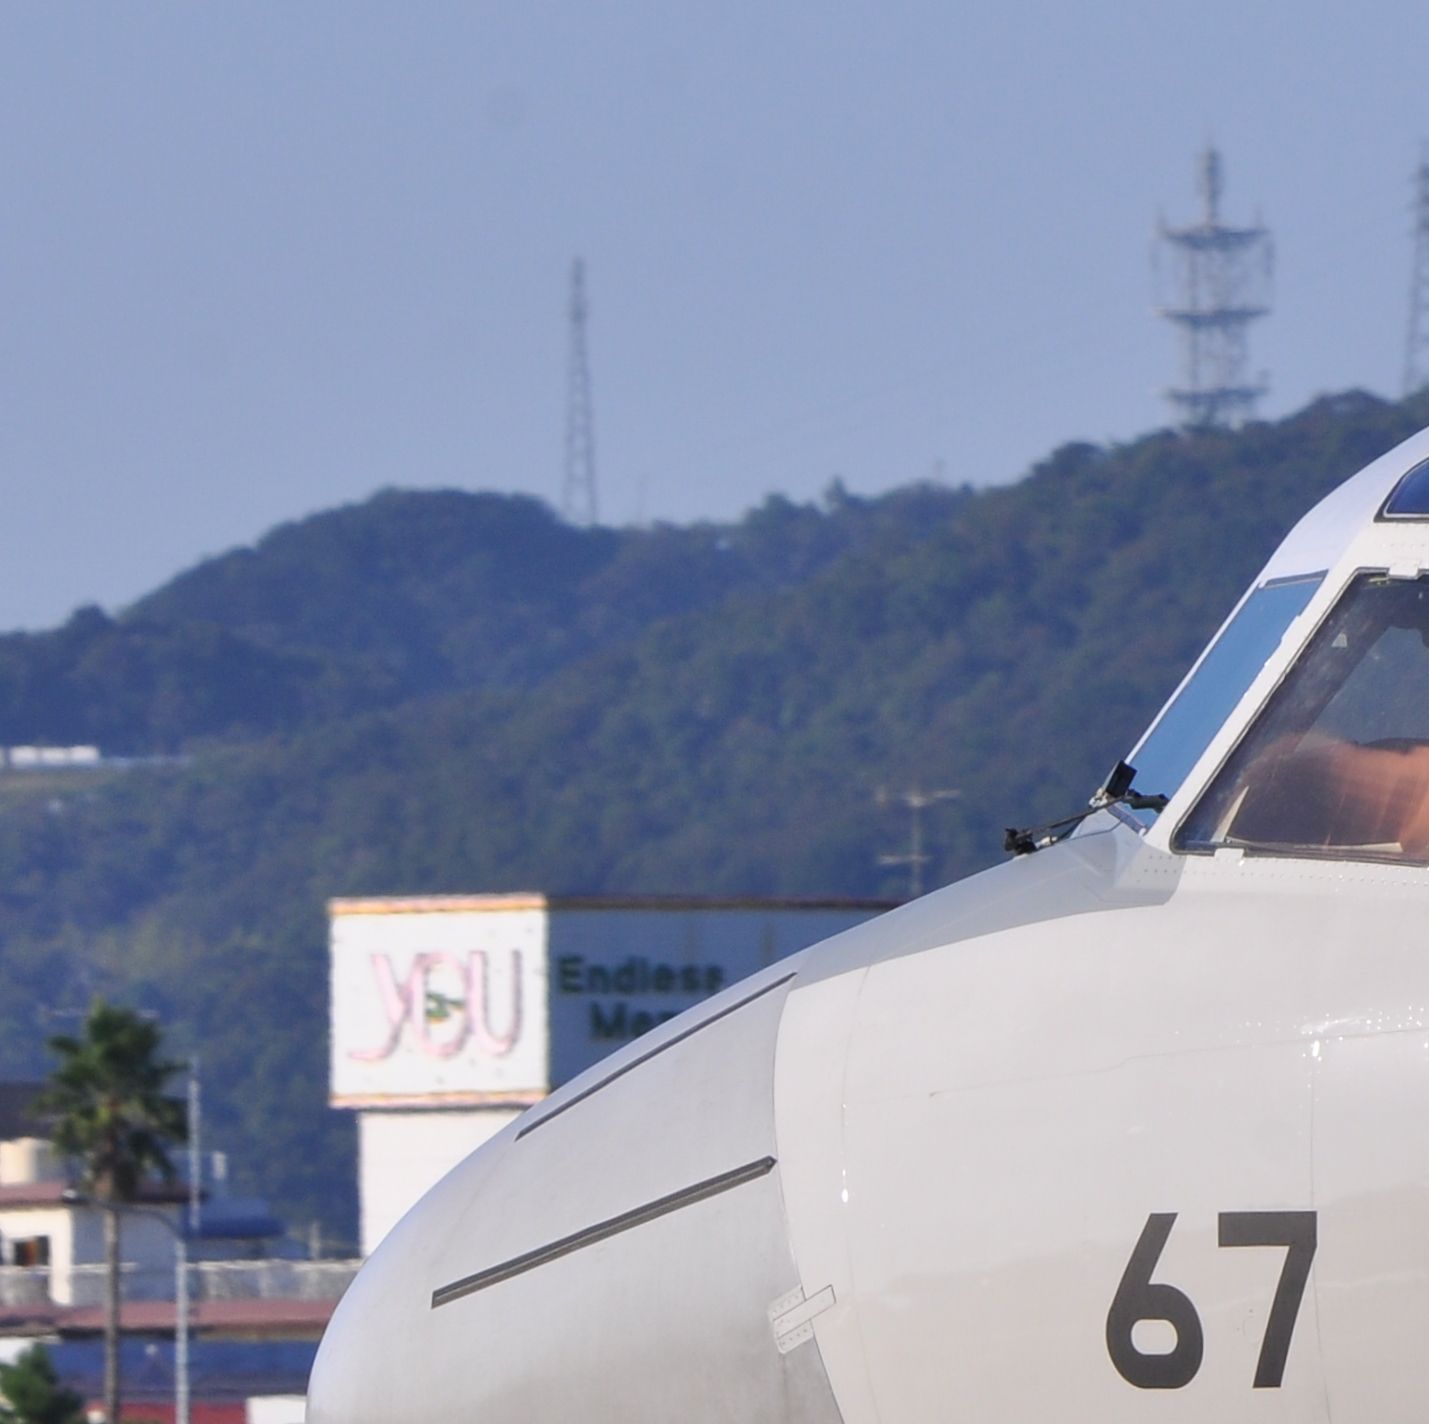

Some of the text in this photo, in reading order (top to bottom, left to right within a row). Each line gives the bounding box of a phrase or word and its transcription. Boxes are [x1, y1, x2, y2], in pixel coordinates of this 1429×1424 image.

[346, 949, 523, 1061] YOU
[558, 954, 725, 993] Endless
[1106, 1211, 1317, 1389] 67
